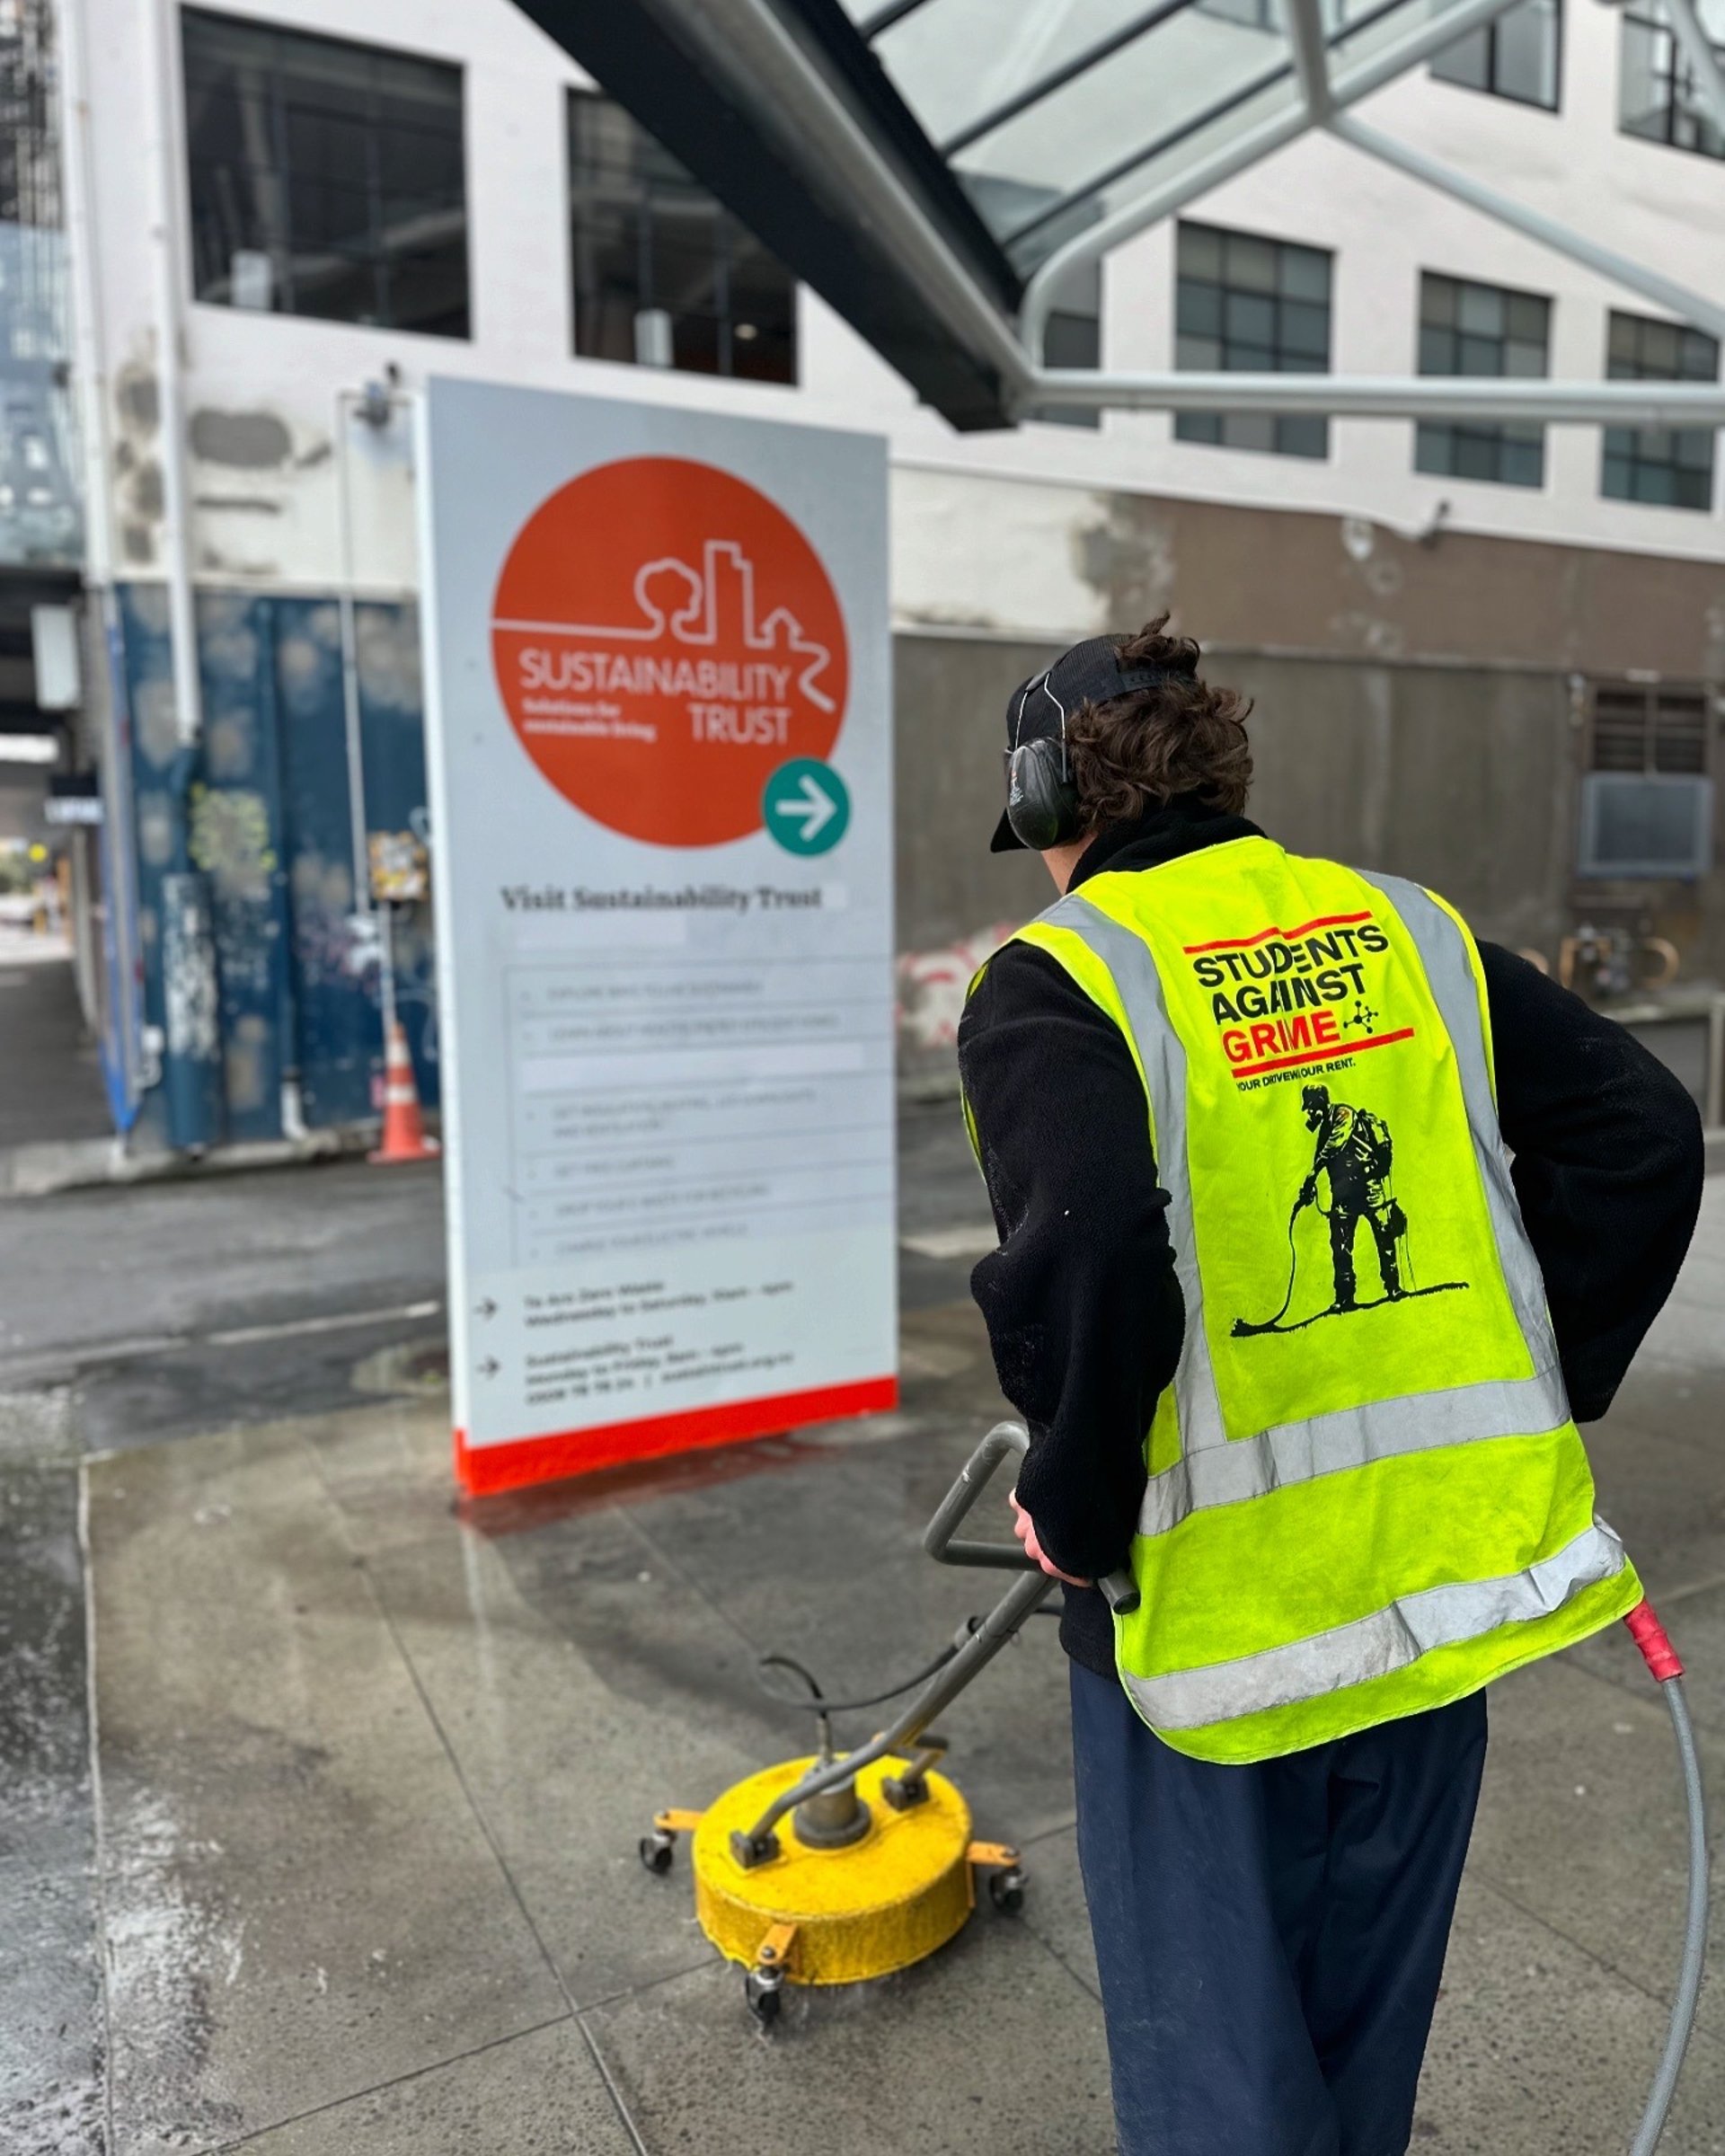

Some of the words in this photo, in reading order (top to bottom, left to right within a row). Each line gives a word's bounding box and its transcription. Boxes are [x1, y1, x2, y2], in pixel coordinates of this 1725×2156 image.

[518, 648, 792, 702] SUSTAINABILITY
[686, 702, 792, 745] TRUST
[500, 885, 565, 911] Visit
[572, 884, 748, 915] Sustainability
[753, 885, 823, 910] Trust
[1193, 924, 1389, 987] STUDENTS
[1212, 963, 1367, 1025] AGAINST
[1221, 1010, 1341, 1063] GRIME
